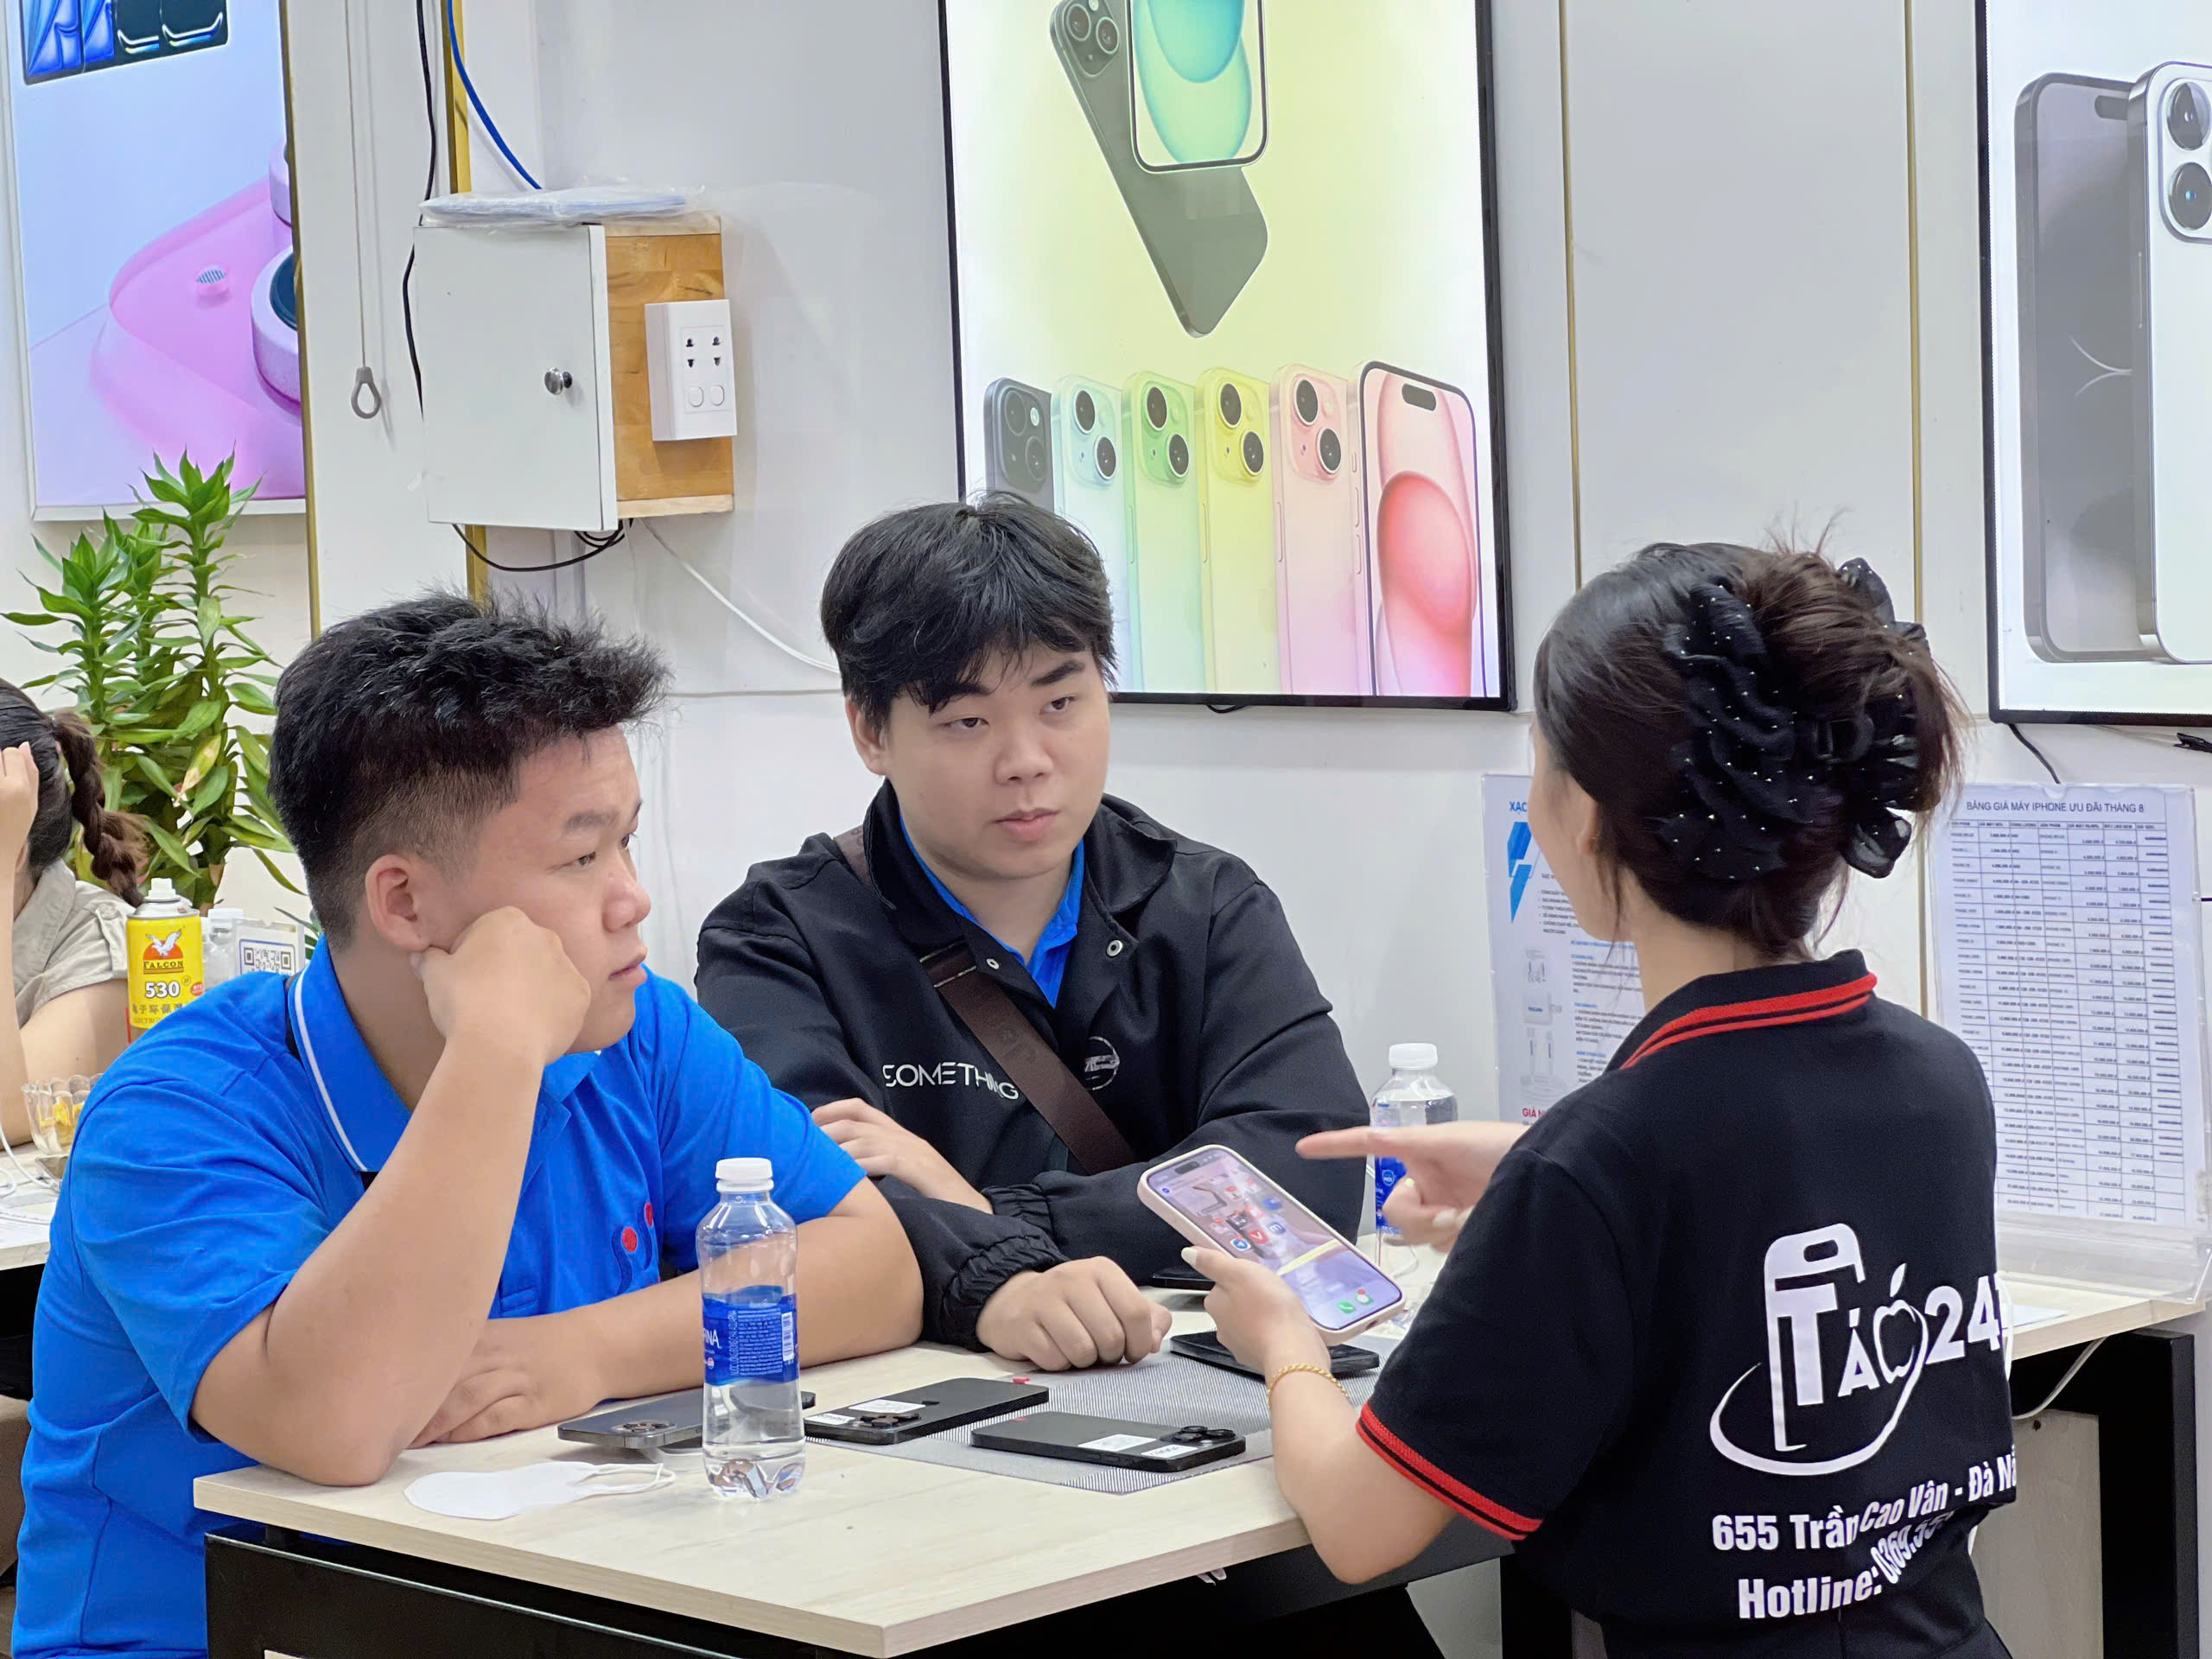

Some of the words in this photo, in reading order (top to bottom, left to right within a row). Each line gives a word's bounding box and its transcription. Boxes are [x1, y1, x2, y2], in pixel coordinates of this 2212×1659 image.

[2012, 801, 2031, 811] MÁY
[2032, 802, 2067, 811] IPHONE
[2103, 802, 2137, 813] THÁNG
[2139, 804, 2145, 813] 8
[143, 960, 184, 969] FALCON
[145, 981, 181, 999] 530
[1712, 1514, 1779, 1551] 655
[1789, 1504, 1860, 1549] Trần
[1859, 1498, 1905, 1533] Cao
[1907, 1480, 1949, 1519] Vân
[1967, 1460, 1994, 1503] Đà
[1738, 1566, 1883, 1619] Hotline:
